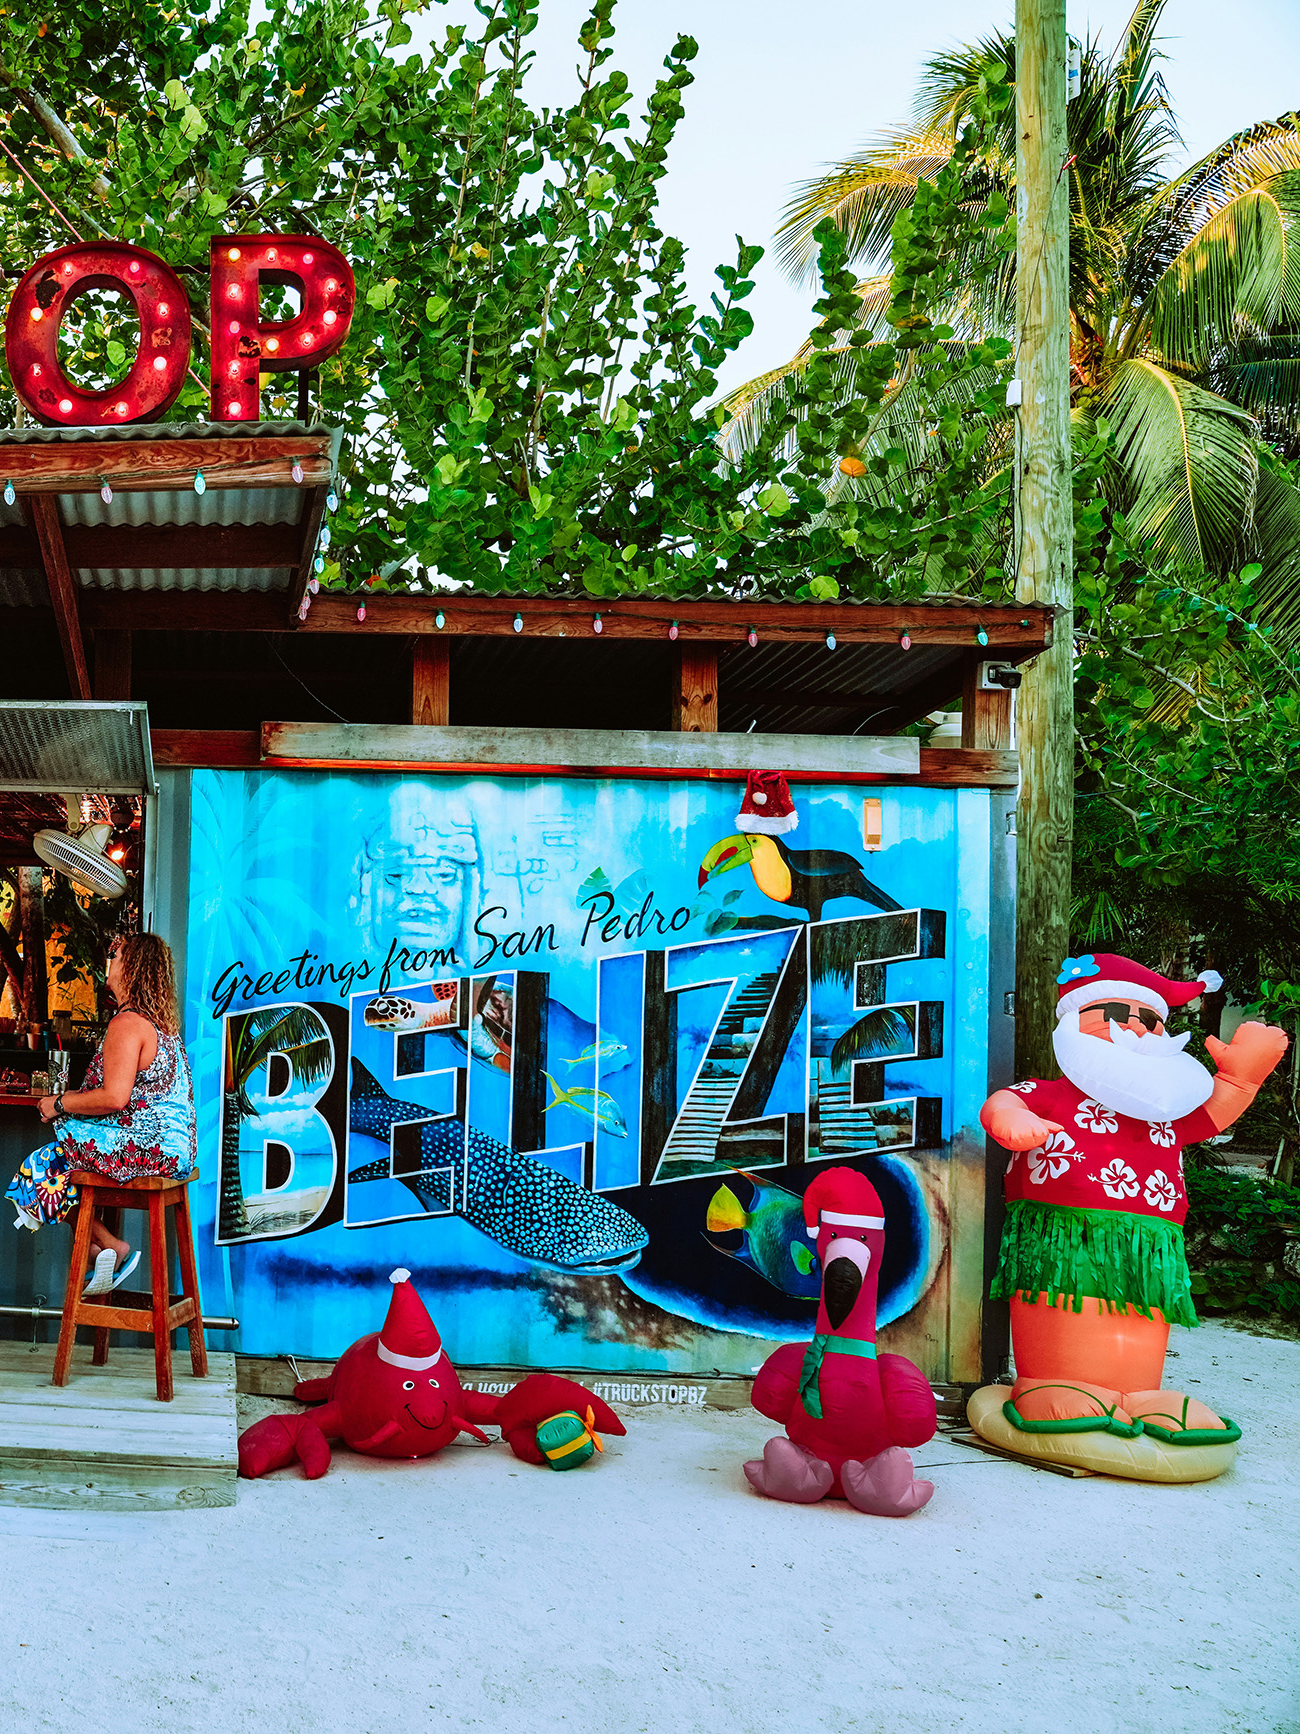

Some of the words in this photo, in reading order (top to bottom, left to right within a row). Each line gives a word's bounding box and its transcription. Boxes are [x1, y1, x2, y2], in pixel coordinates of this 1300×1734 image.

[211, 948, 375, 1019] Greetings
[380, 937, 458, 994] from
[473, 906, 560, 970] San
[580, 891, 691, 947] Pedro
[215, 908, 946, 1246] BELIZE
[593, 1381, 708, 1405] #TRUCKSTOPBZ
